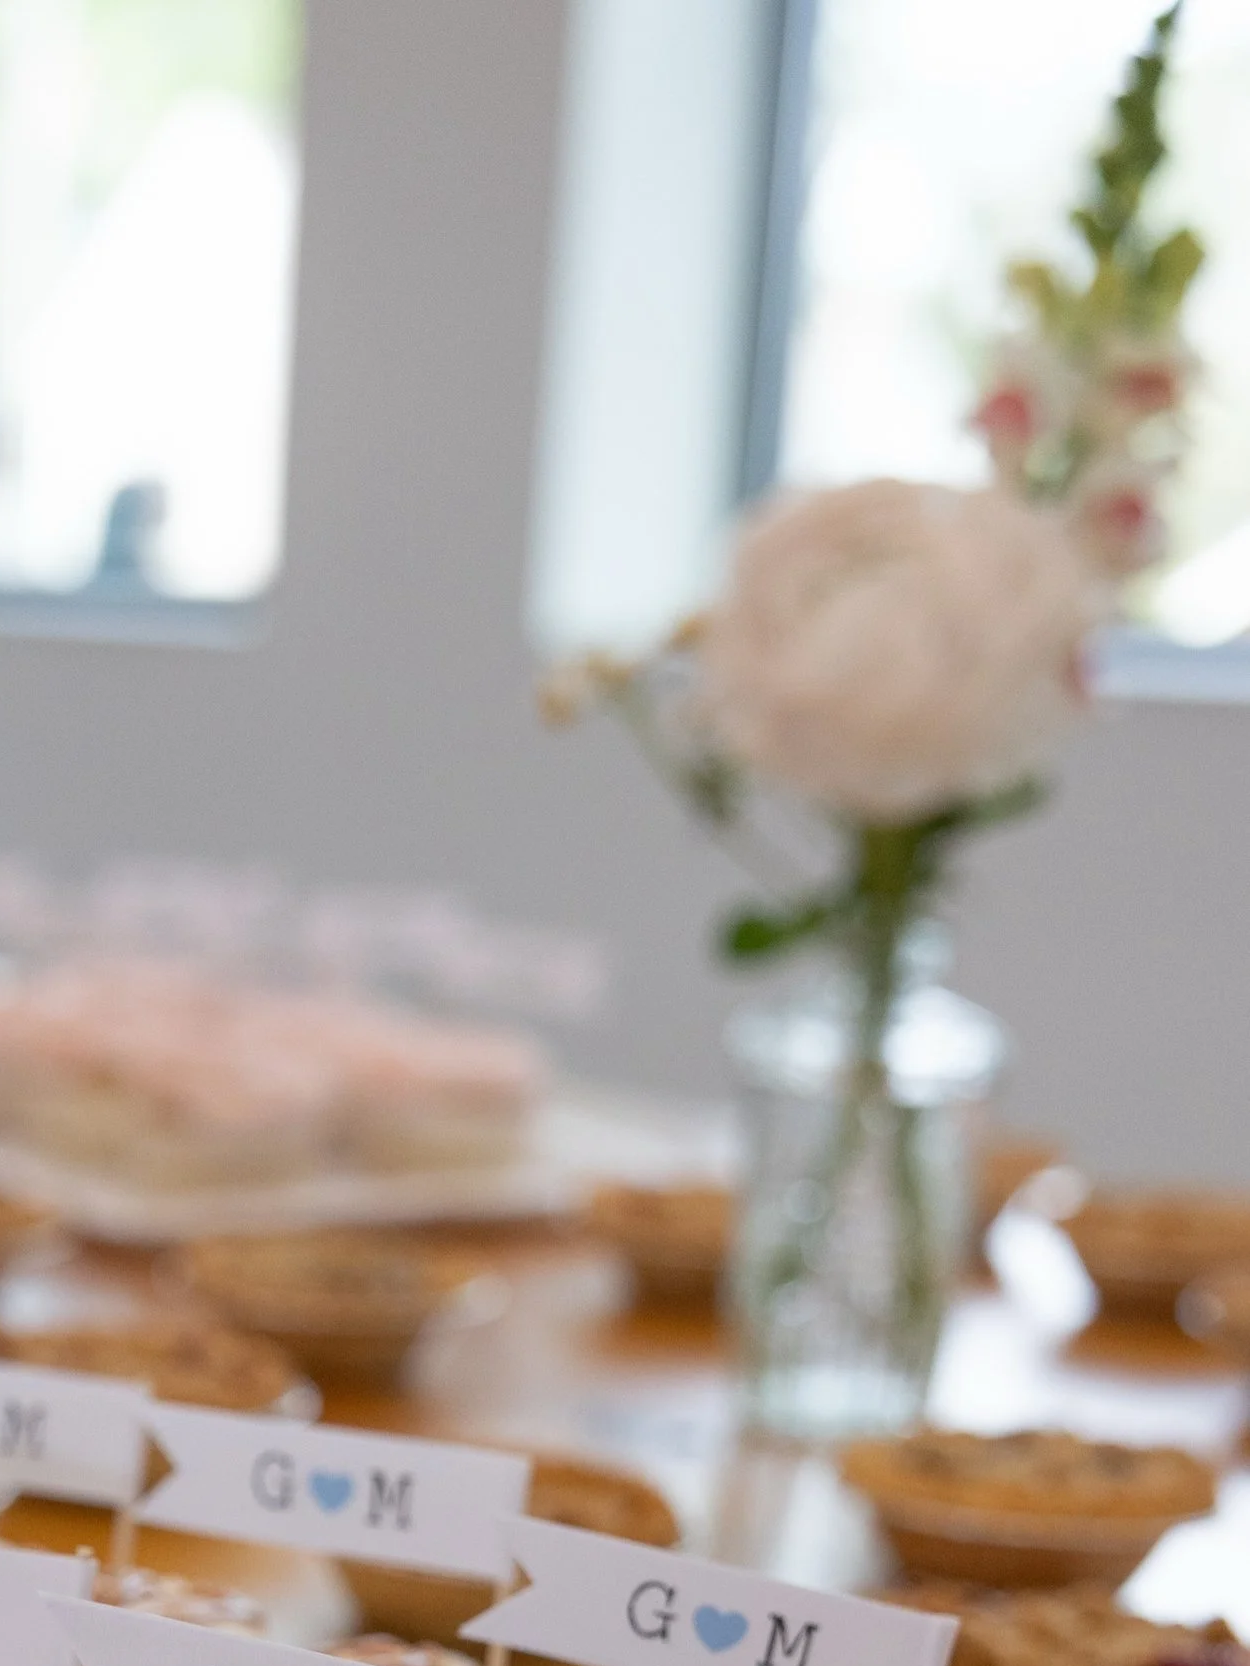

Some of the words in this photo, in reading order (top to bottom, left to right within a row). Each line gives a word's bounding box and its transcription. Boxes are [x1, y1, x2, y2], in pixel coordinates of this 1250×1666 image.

[250, 1449, 299, 1512] G
[365, 1468, 415, 1531] M
[626, 1580, 678, 1642] G
